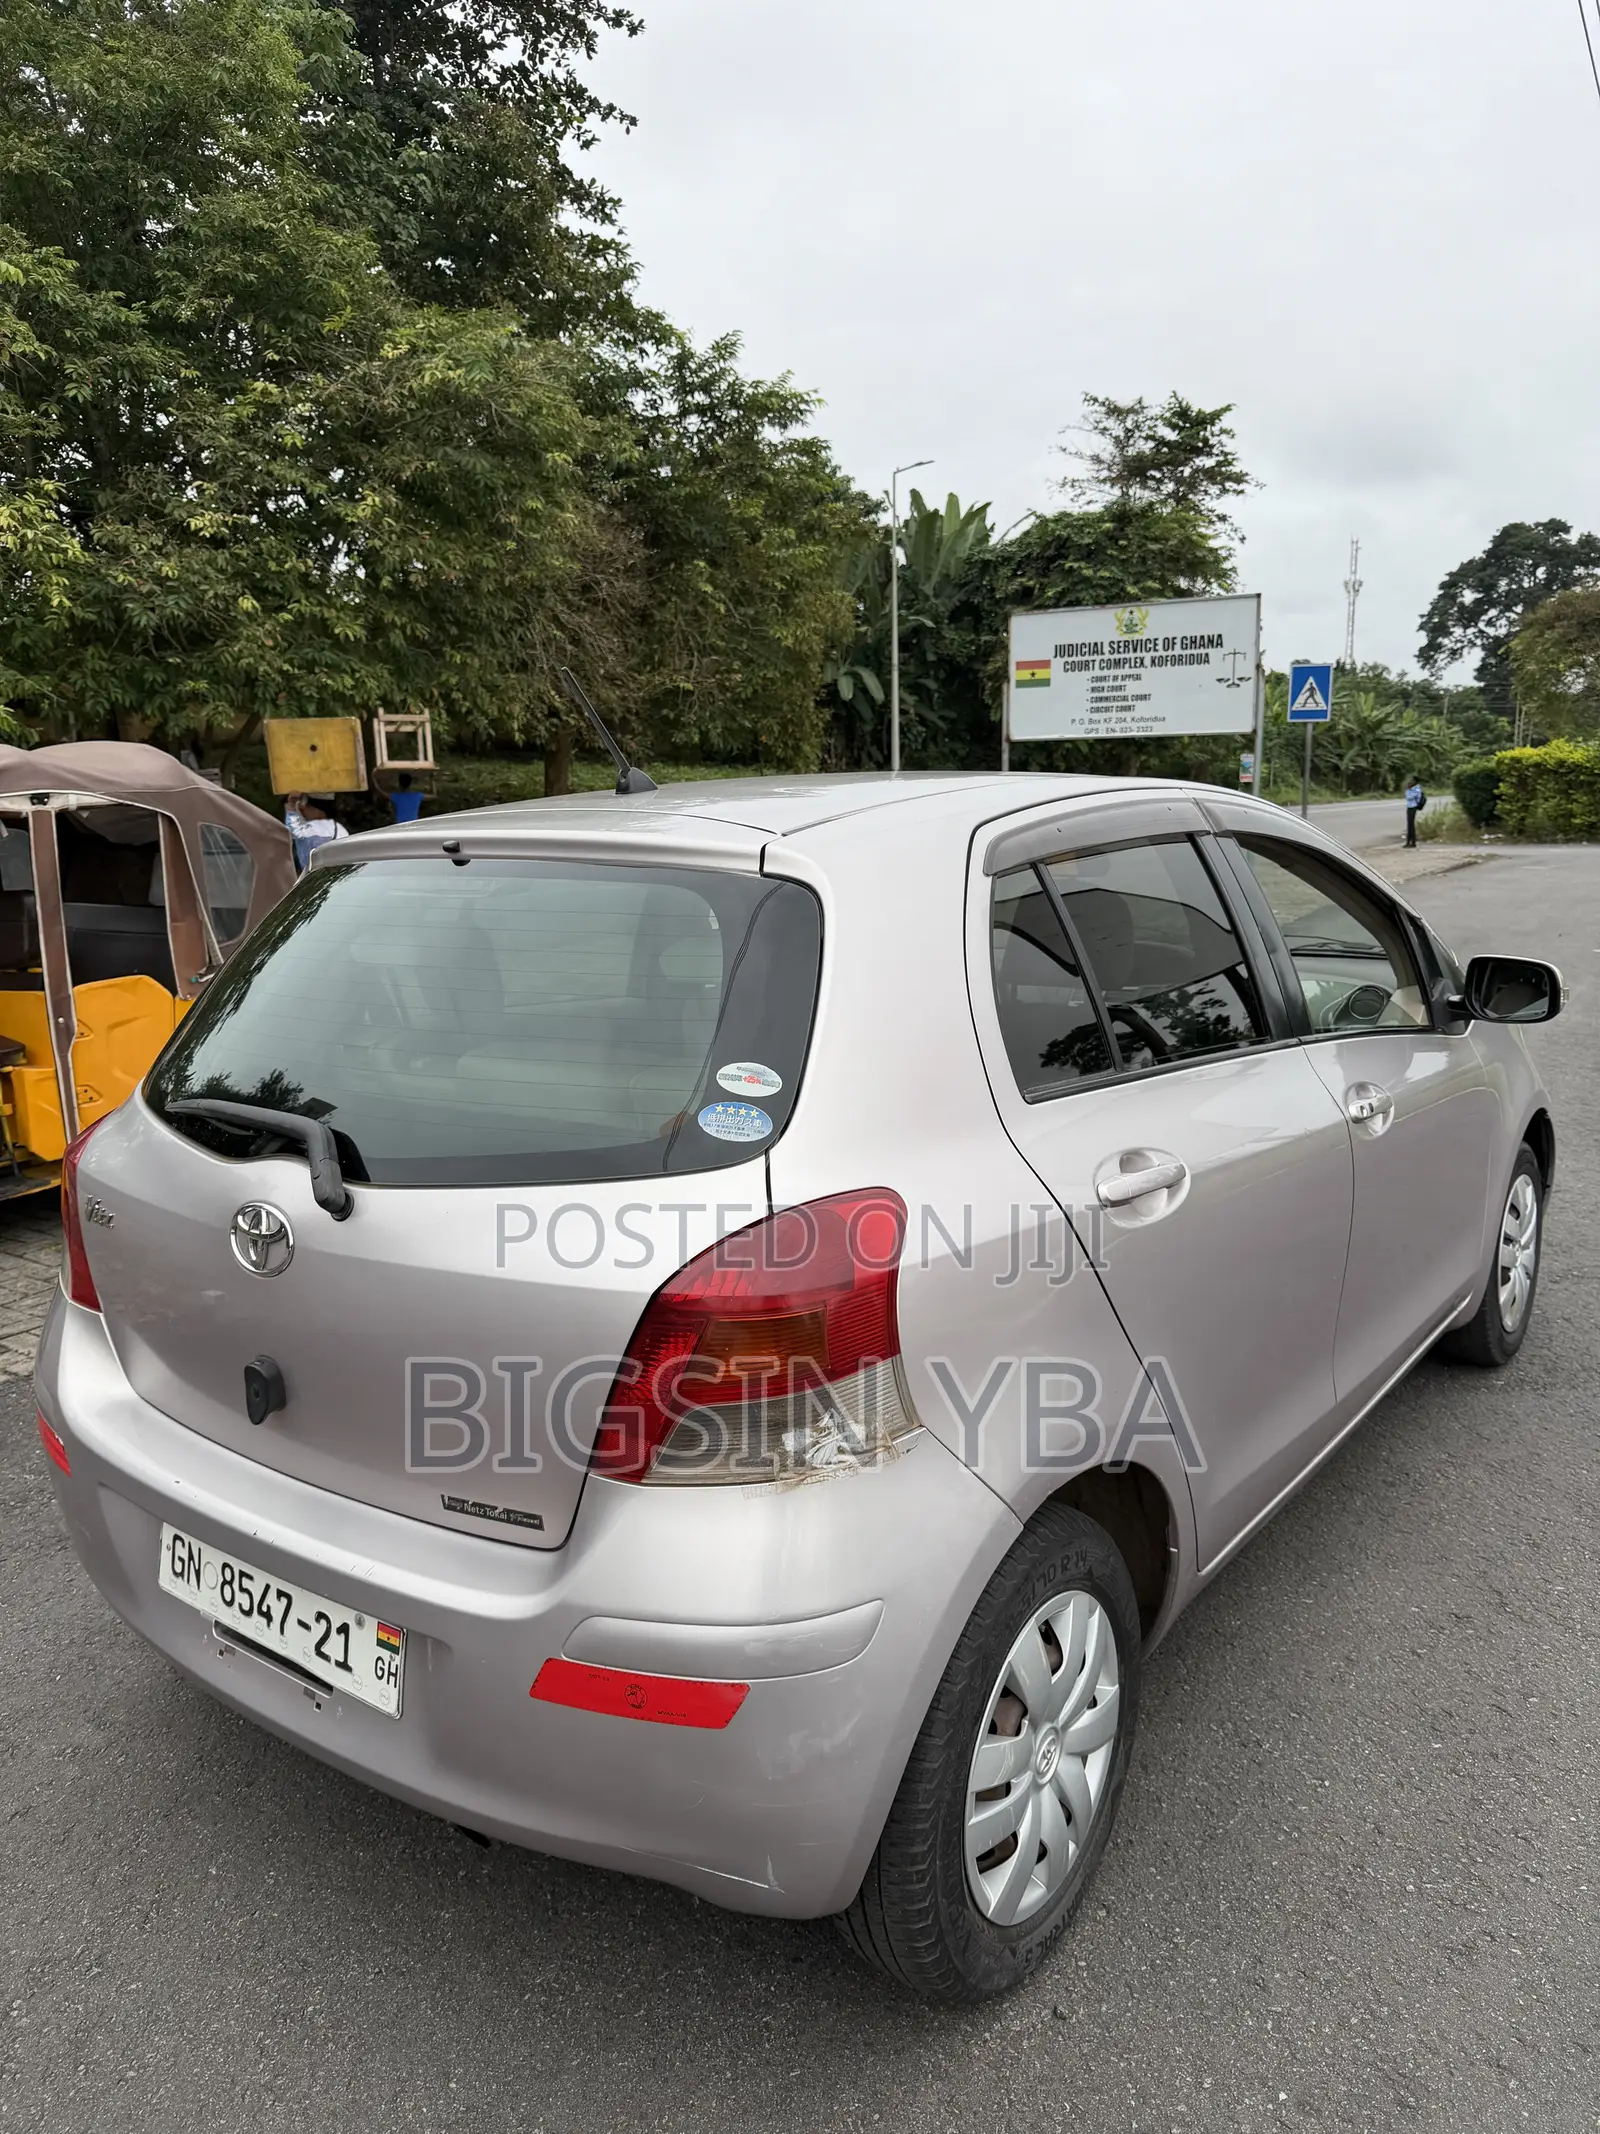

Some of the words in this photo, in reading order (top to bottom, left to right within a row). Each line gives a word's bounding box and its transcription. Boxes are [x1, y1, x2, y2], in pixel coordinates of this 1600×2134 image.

[1053, 641, 1105, 659] JUDICIAL
[1108, 638, 1159, 655] SERVICE
[1162, 637, 1178, 652] OF
[1180, 634, 1224, 651] GHANA
[1063, 659, 1096, 673] COURT
[1150, 652, 1211, 668] KOFORIDUA
[1091, 675, 1111, 684] COURT
[1112, 674, 1120, 683] OF
[1121, 673, 1142, 682] APPEAL
[1090, 685, 1105, 694] HIGH
[1106, 684, 1127, 693] COURT
[1090, 695, 1130, 704] COMMERCIAL
[1131, 693, 1152, 702] COURT
[1089, 705, 1114, 714] CIRCUIT
[1115, 704, 1136, 713] COURT
[1088, 717, 1101, 725] Box
[1131, 715, 1166, 723] Koforidua
[463, 1502, 485, 1516] Netz
[171, 1533, 202, 1591] GN
[220, 1562, 353, 1674] 8547-21
[374, 1655, 399, 1689] GH
